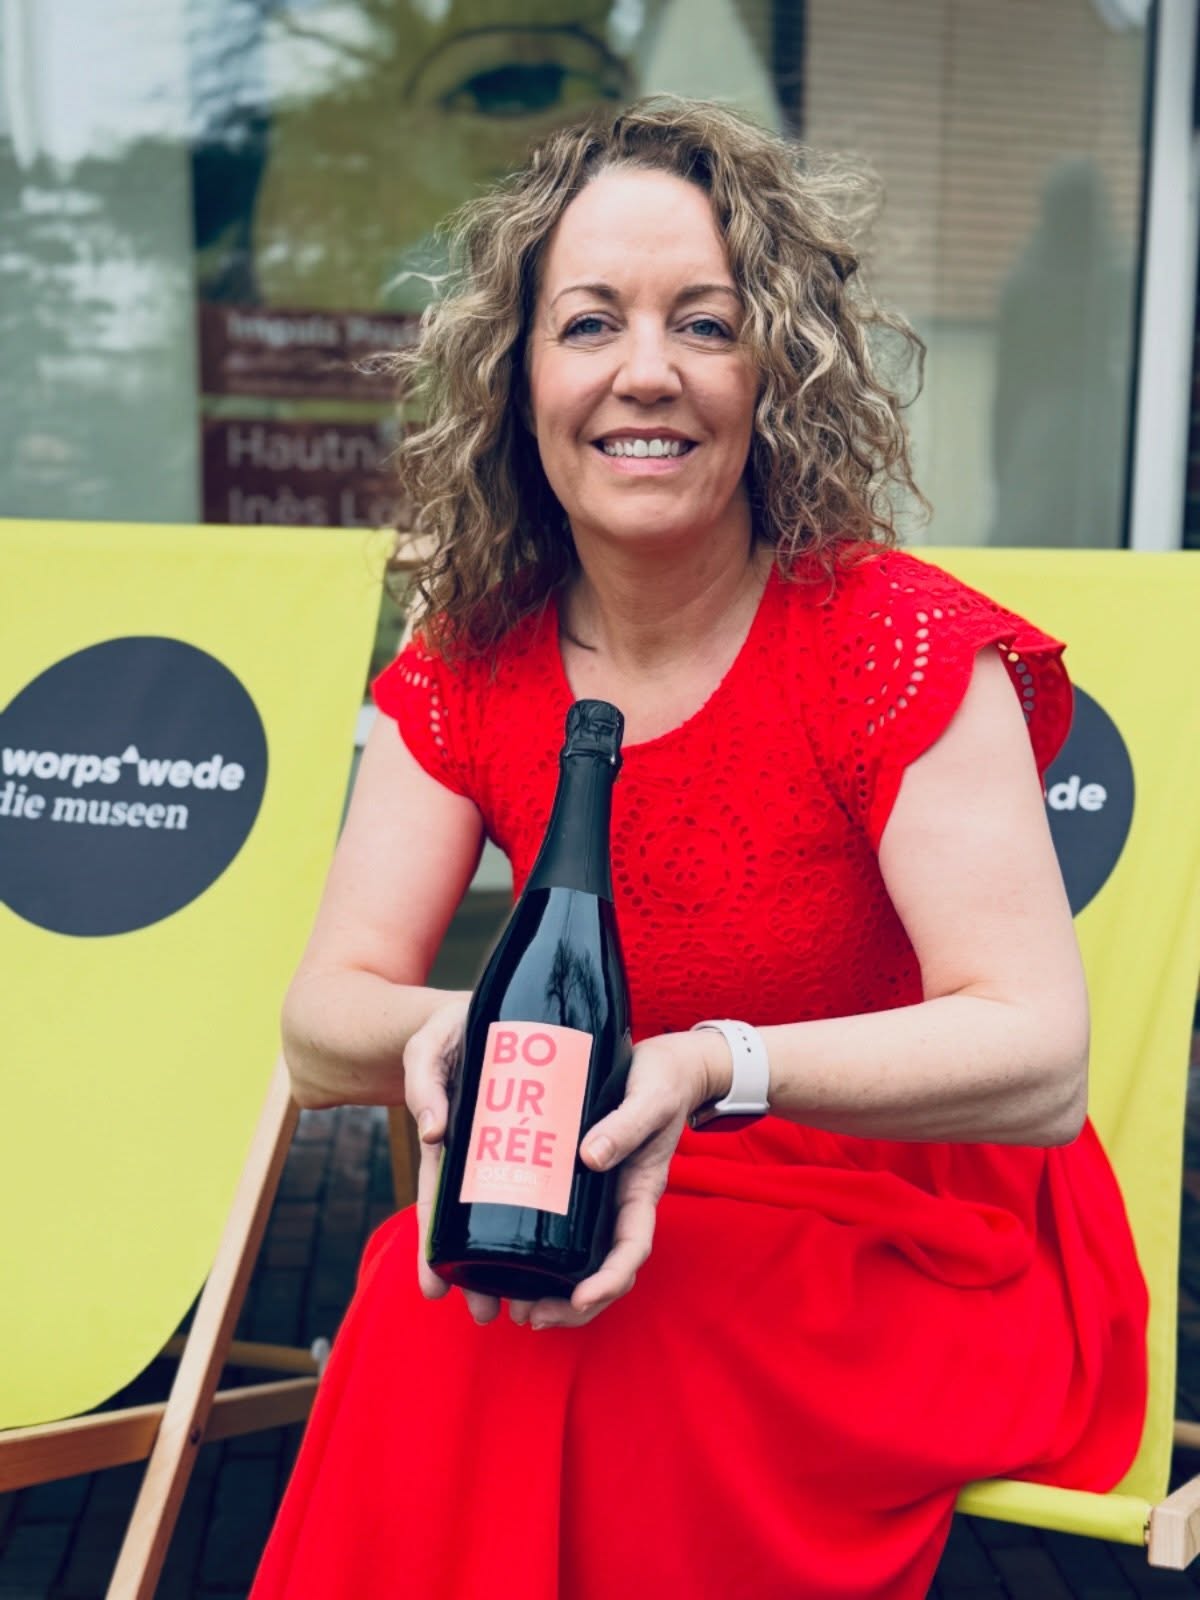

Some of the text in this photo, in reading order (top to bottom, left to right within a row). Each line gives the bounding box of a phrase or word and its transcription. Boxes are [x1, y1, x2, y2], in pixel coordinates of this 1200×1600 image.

[51, 796, 189, 830] museen
[492, 1031, 558, 1067] BO
[484, 1077, 545, 1116] UR
[475, 1117, 558, 1169] RÉE
